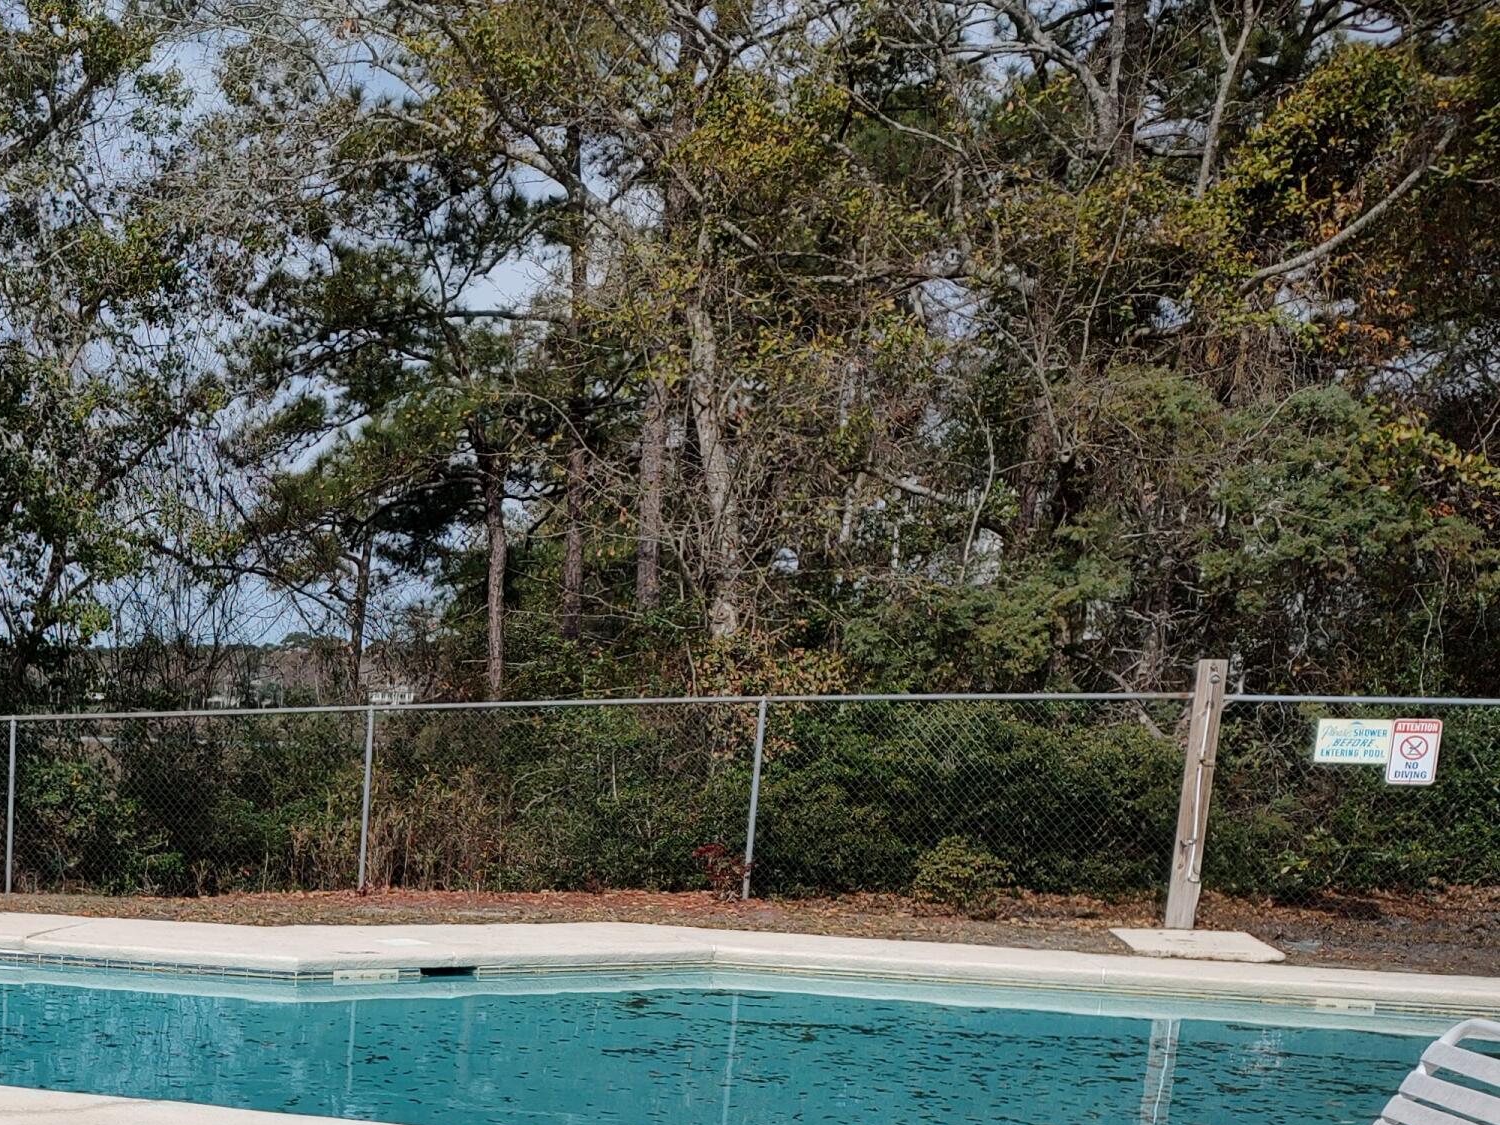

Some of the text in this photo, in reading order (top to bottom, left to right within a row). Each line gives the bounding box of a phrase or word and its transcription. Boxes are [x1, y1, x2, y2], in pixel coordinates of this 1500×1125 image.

[1396, 722, 1439, 732] ATTENTION
[1354, 729, 1388, 738] SHOWER
[1332, 738, 1375, 747] BEFORE
[1320, 748, 1385, 758] ENTERING POOL
[1404, 761, 1419, 770] NO
[1394, 770, 1427, 779] DIVING
